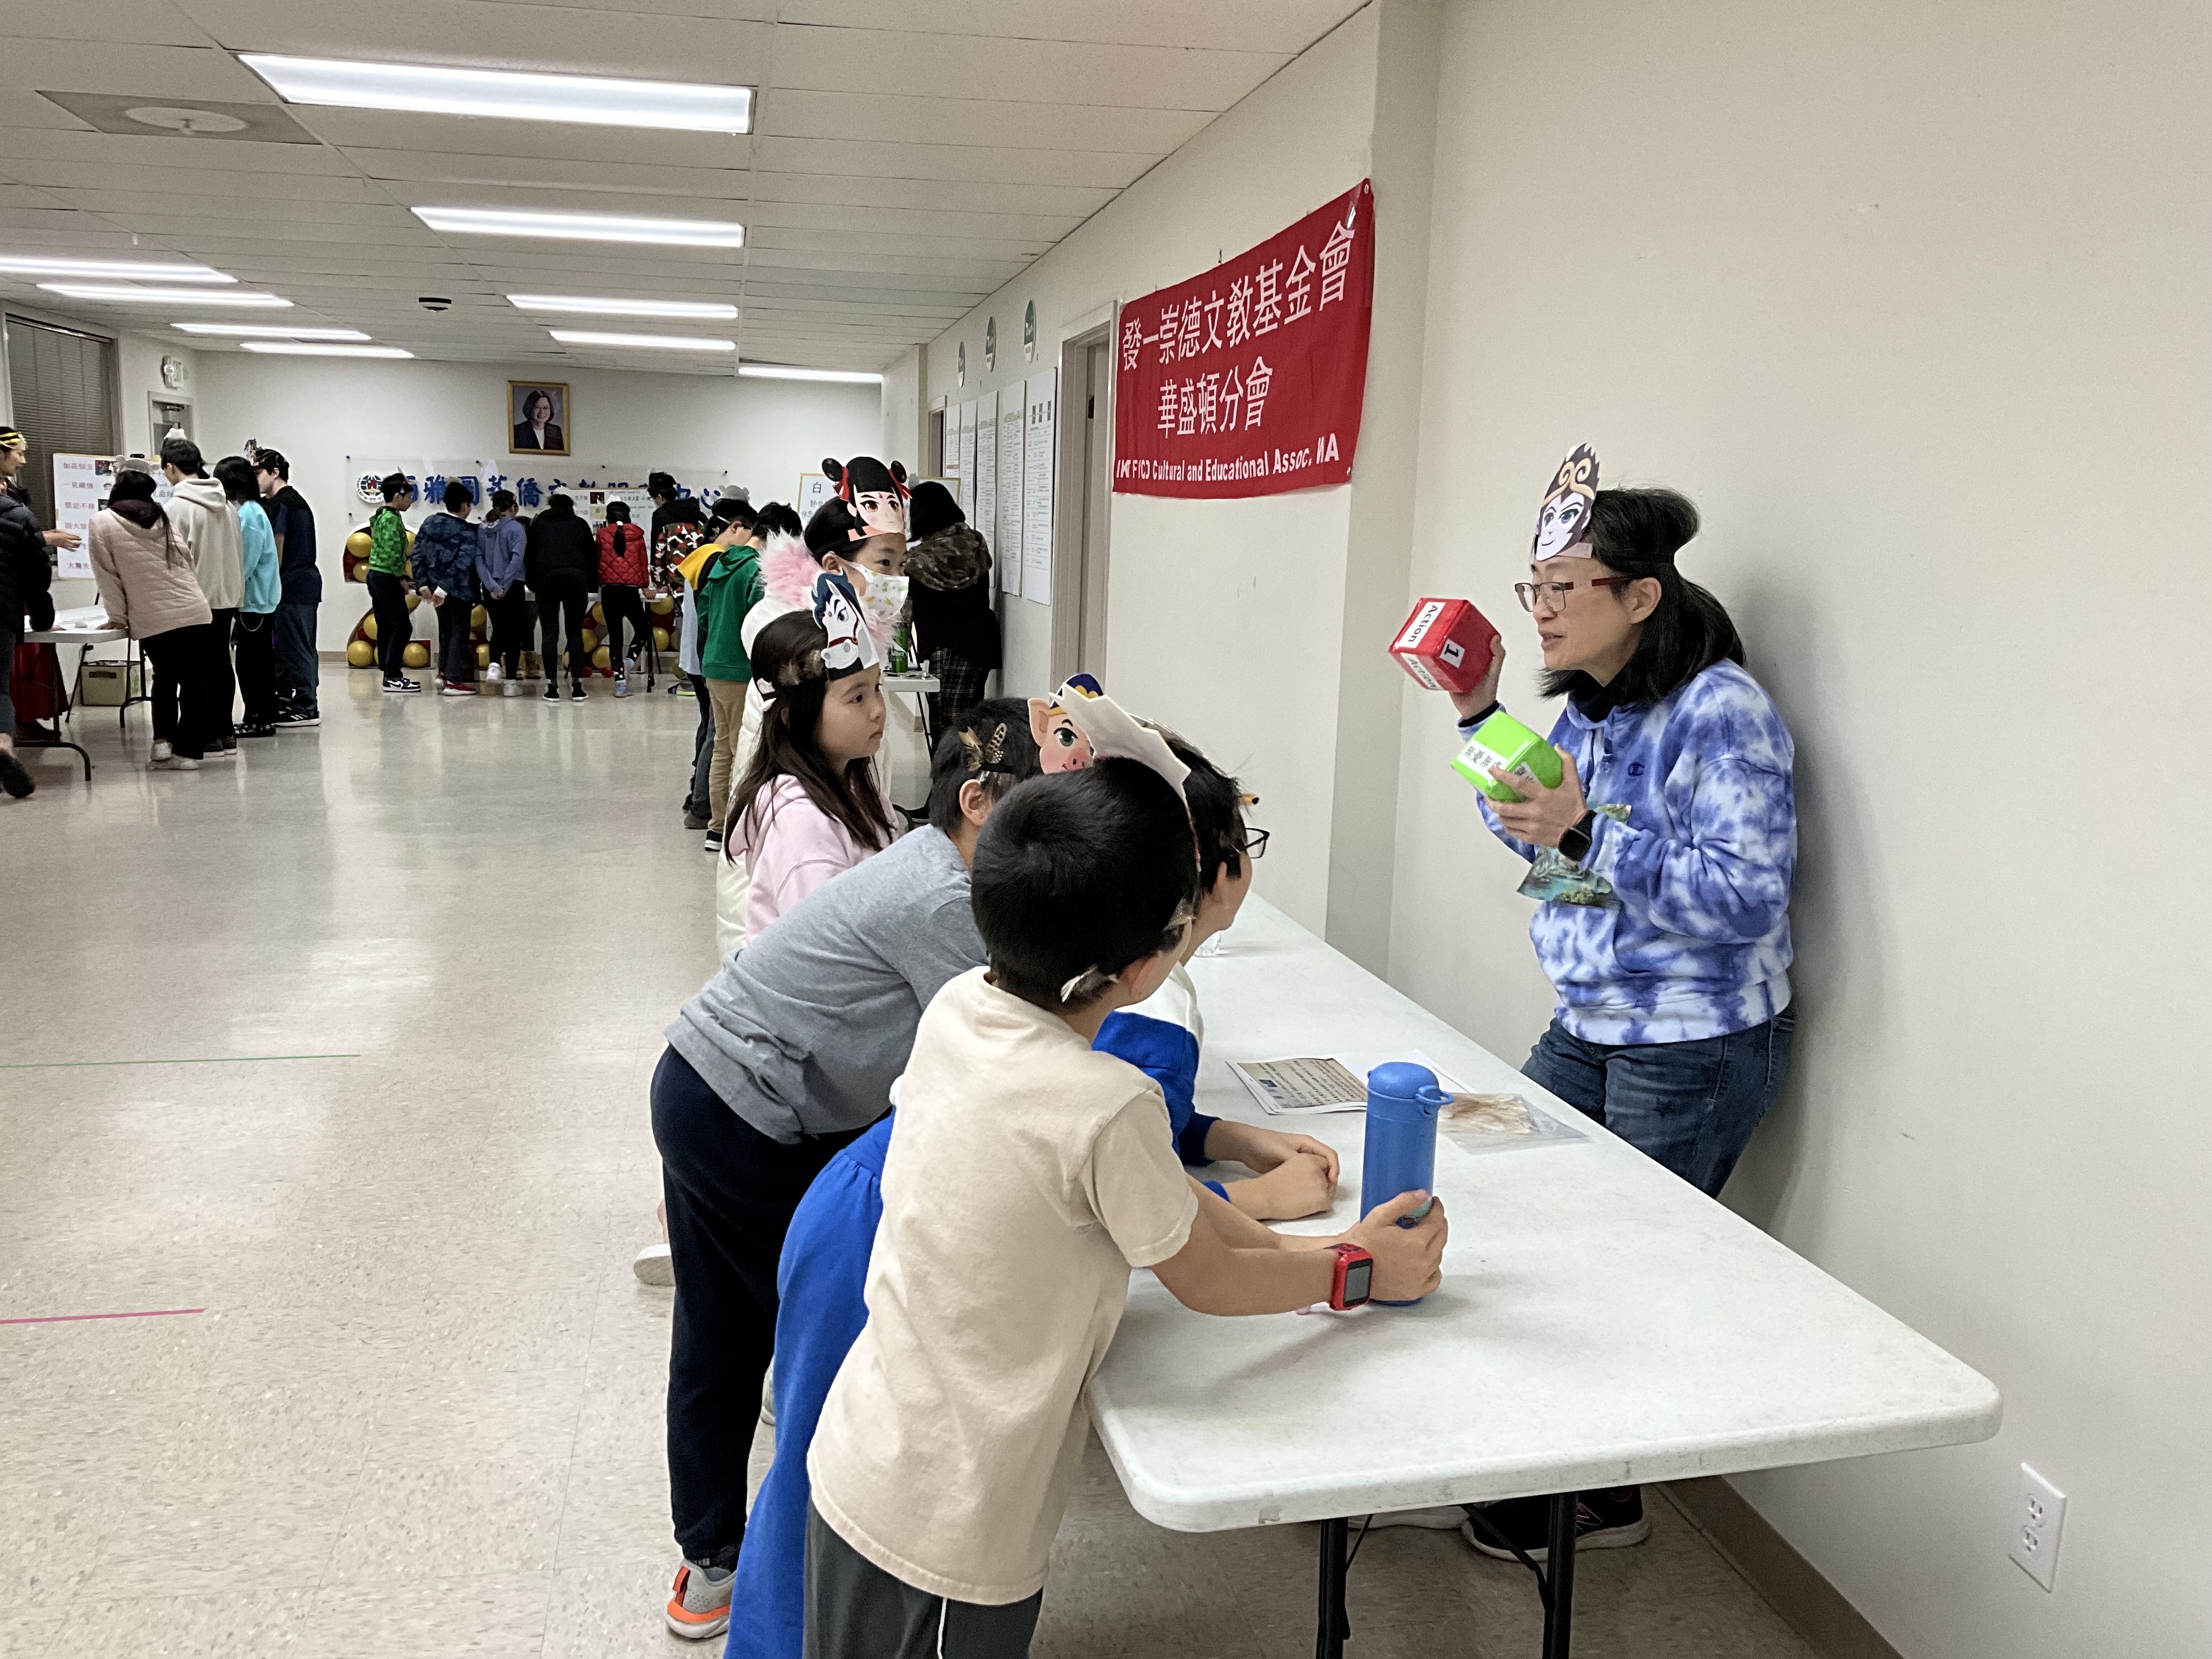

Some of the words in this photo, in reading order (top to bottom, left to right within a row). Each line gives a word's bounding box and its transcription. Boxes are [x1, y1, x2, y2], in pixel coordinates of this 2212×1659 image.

[1123, 221, 1355, 371] 發一崇德文教基金會
[1157, 356, 1273, 439] 華盛頓分會
[1153, 459, 1185, 481] Cultural
[1187, 459, 1203, 482] and
[1205, 451, 1269, 482] Educational
[1408, 604, 1438, 642] Action
[1444, 644, 1460, 658] 1
[1407, 658, 1436, 688] Action
